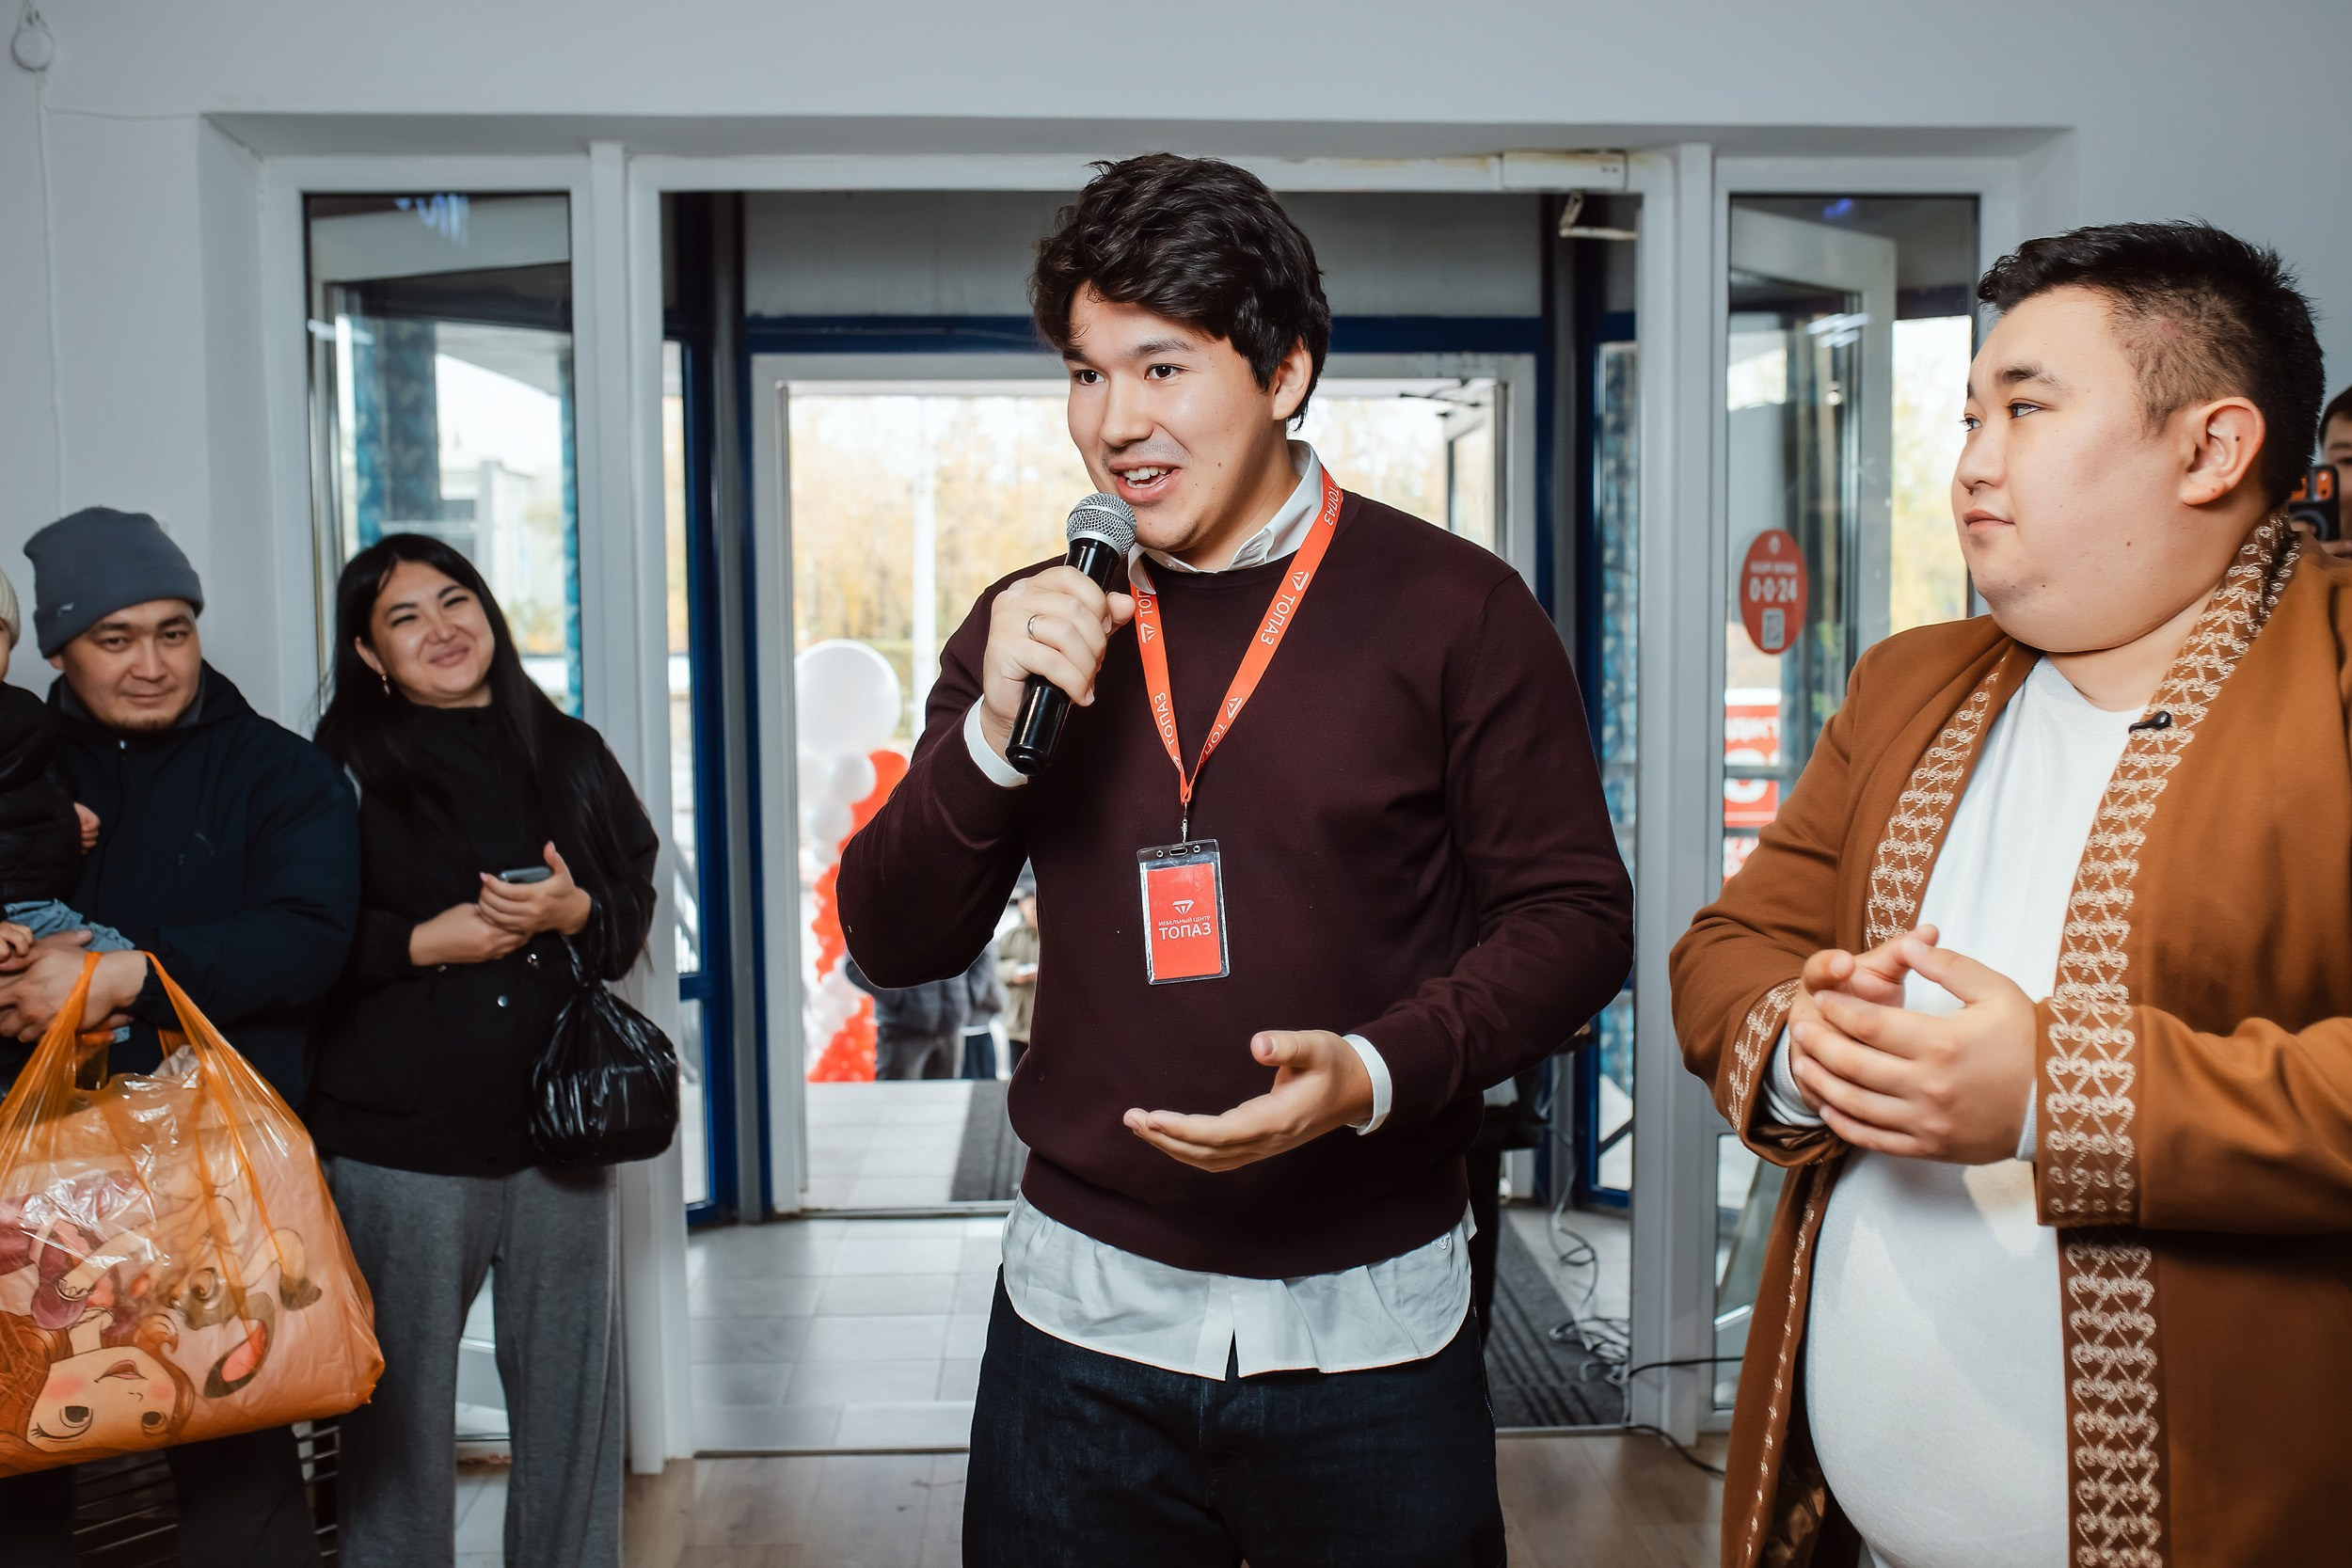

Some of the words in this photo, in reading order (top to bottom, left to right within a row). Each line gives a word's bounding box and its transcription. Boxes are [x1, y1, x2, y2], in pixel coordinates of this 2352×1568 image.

[1324, 485, 1340, 526] ТОПАЗ
[1136, 589, 1153, 618] ТОП
[1261, 594, 1296, 645] ТОПАЗ
[1153, 691, 1175, 750] ТОПАЗ
[1200, 723, 1228, 763] ТОП
[1158, 916, 1192, 927] МЕБЕЛЬНЫЙ
[1158, 922, 1212, 941] ТОПАЗ
